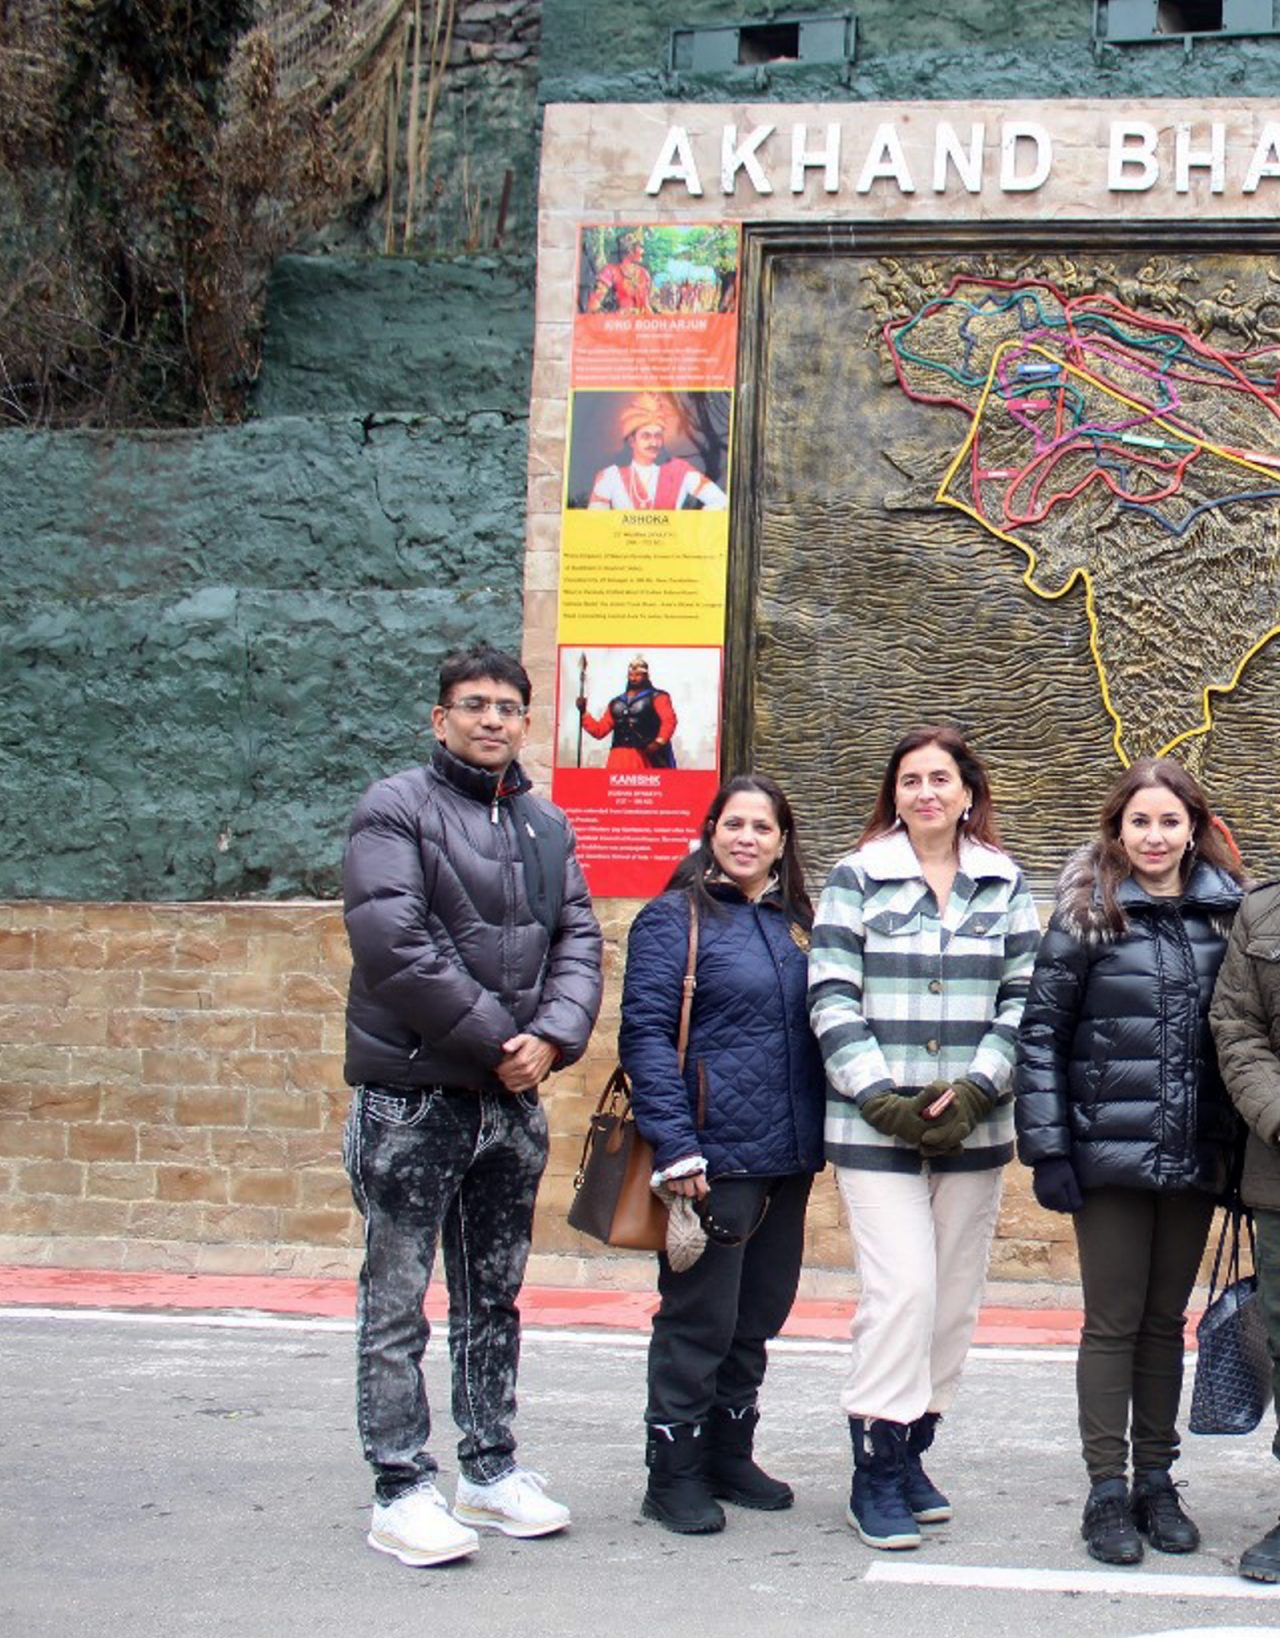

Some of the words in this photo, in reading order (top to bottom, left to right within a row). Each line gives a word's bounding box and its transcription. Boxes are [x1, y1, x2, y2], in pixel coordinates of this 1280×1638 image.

[645, 121, 1053, 196] AKHAND
[671, 319, 708, 332] ARJUN
[622, 514, 669, 525] ASHOKA
[609, 774, 661, 786] KANISHK
